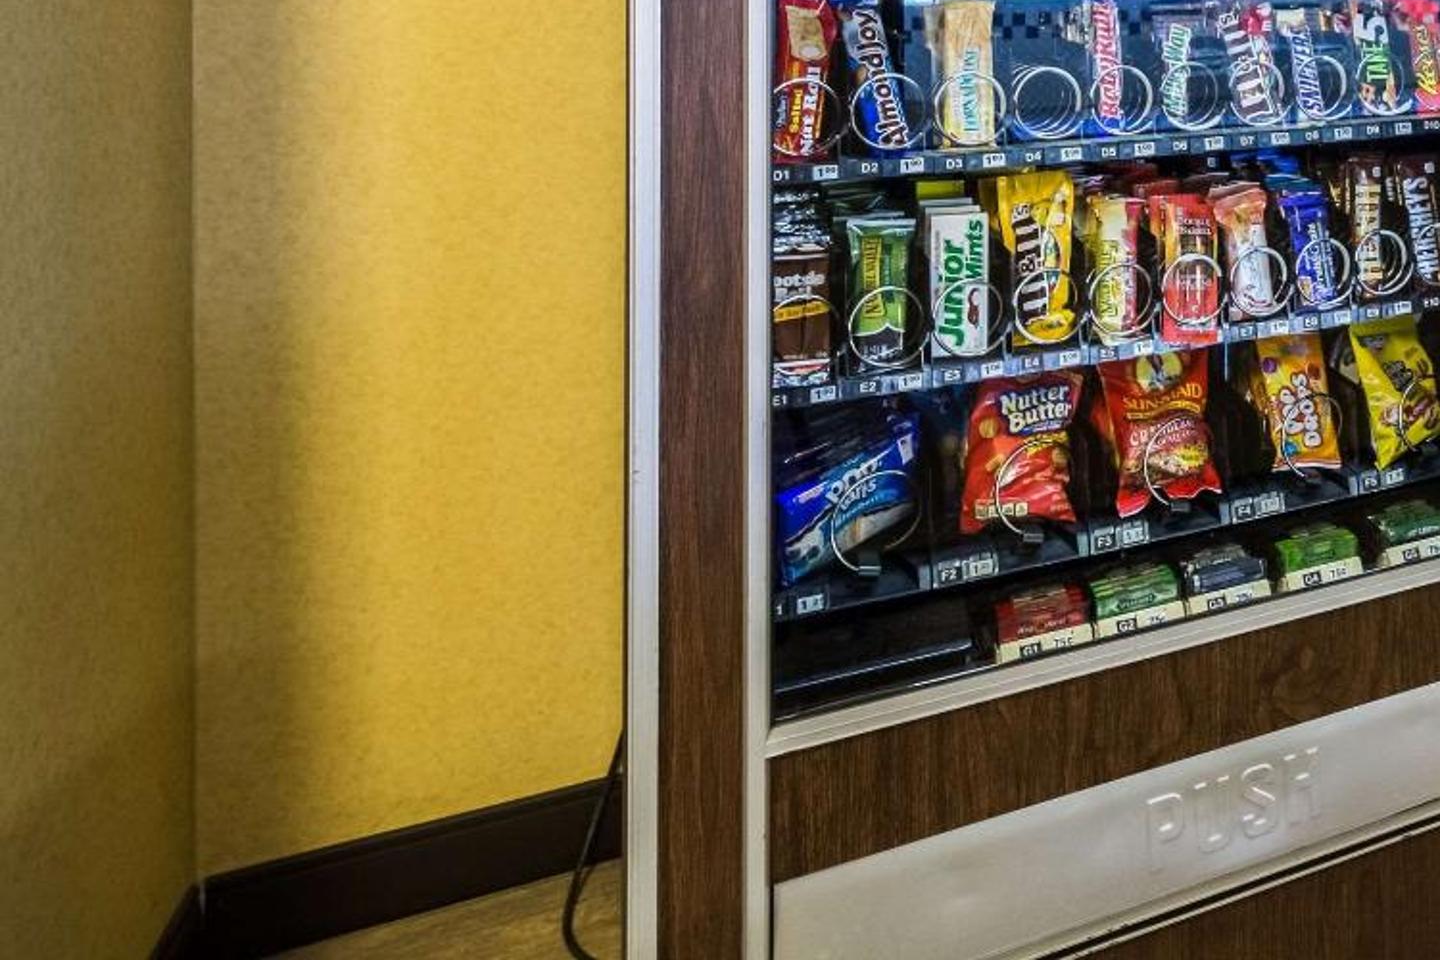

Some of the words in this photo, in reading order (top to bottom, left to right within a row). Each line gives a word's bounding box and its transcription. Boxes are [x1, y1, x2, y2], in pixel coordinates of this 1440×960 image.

[861, 50, 910, 148] Almond
[1289, 24, 1325, 117] SNICKERS
[937, 240, 967, 348] Junior
[965, 219, 985, 279] Mints
[1000, 384, 1070, 416] Nutter
[1008, 402, 1073, 434] Butter
[1146, 746, 1322, 873] PUSH
